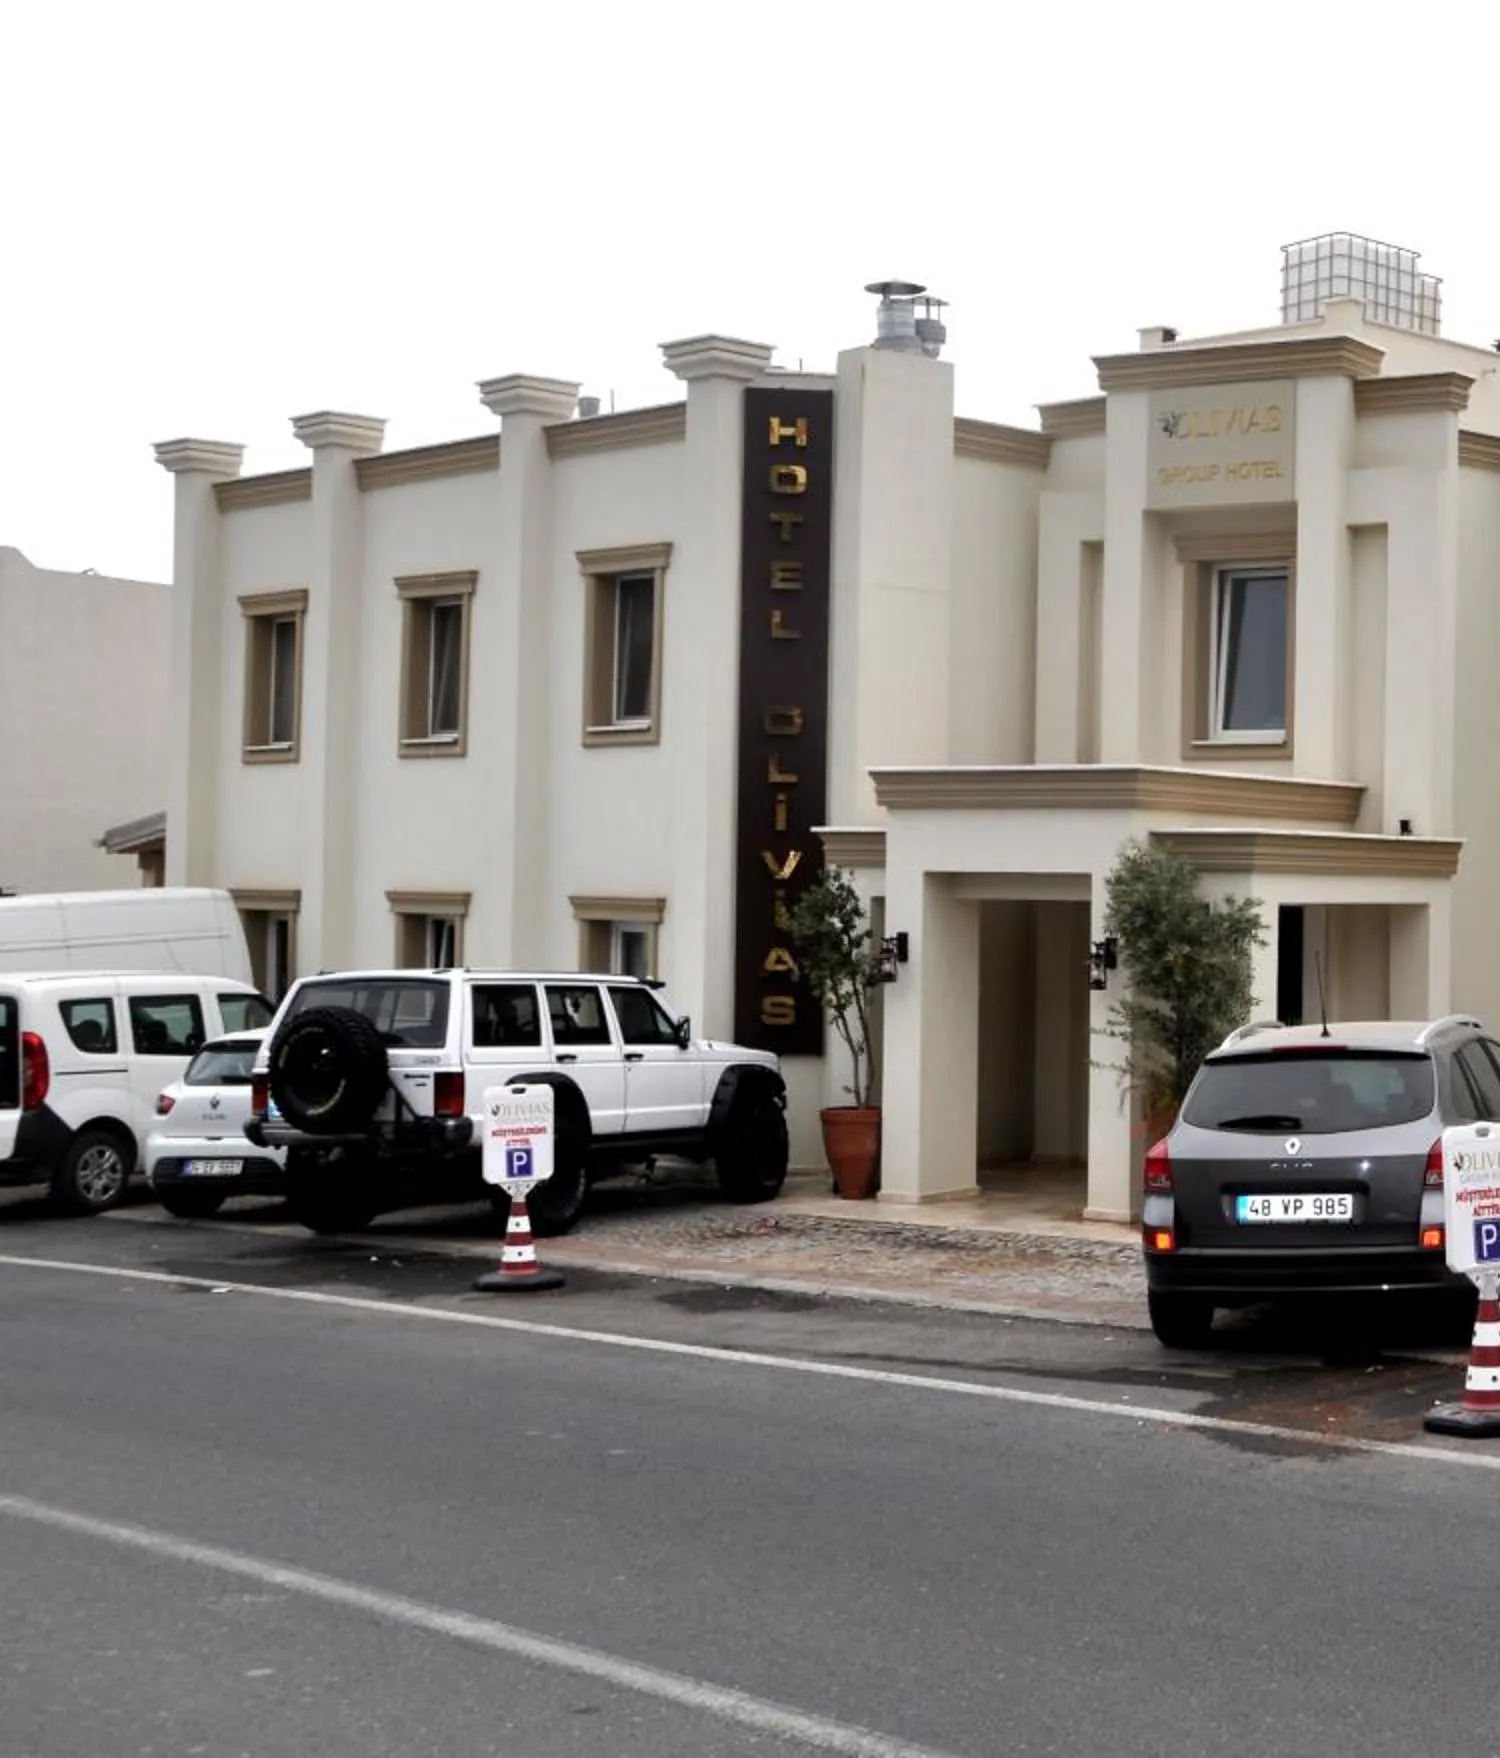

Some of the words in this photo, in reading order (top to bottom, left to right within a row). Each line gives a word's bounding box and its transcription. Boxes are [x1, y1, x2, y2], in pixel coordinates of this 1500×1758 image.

[1224, 460, 1285, 482] HOTEL
[768, 416, 807, 640] HOTEL
[1249, 1199, 1271, 1217] 48
[1281, 1199, 1304, 1215] VP
[1313, 1197, 1349, 1215] 985
